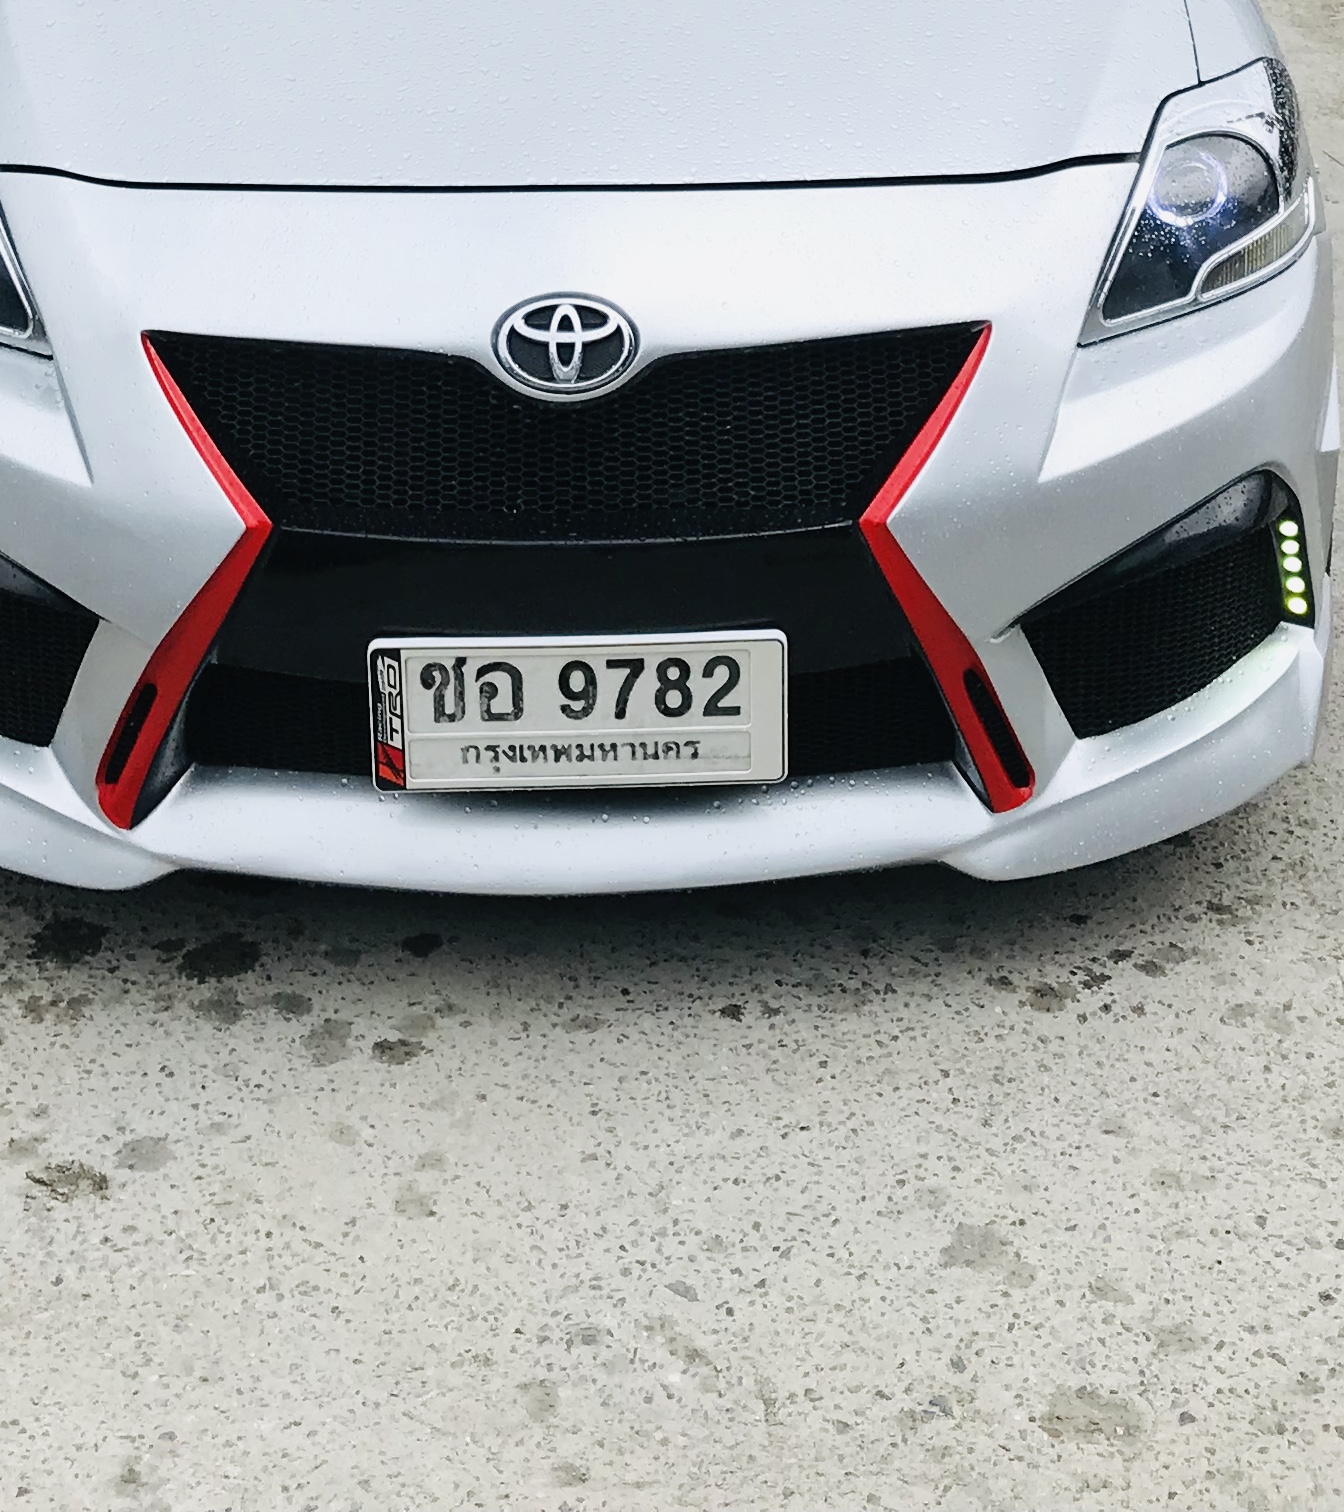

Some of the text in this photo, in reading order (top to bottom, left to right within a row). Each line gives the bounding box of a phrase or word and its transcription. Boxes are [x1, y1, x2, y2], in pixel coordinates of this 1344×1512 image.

[419, 655, 742, 724] ชอ 9782
[460, 740, 702, 774] กรุงเทพมหานคร
